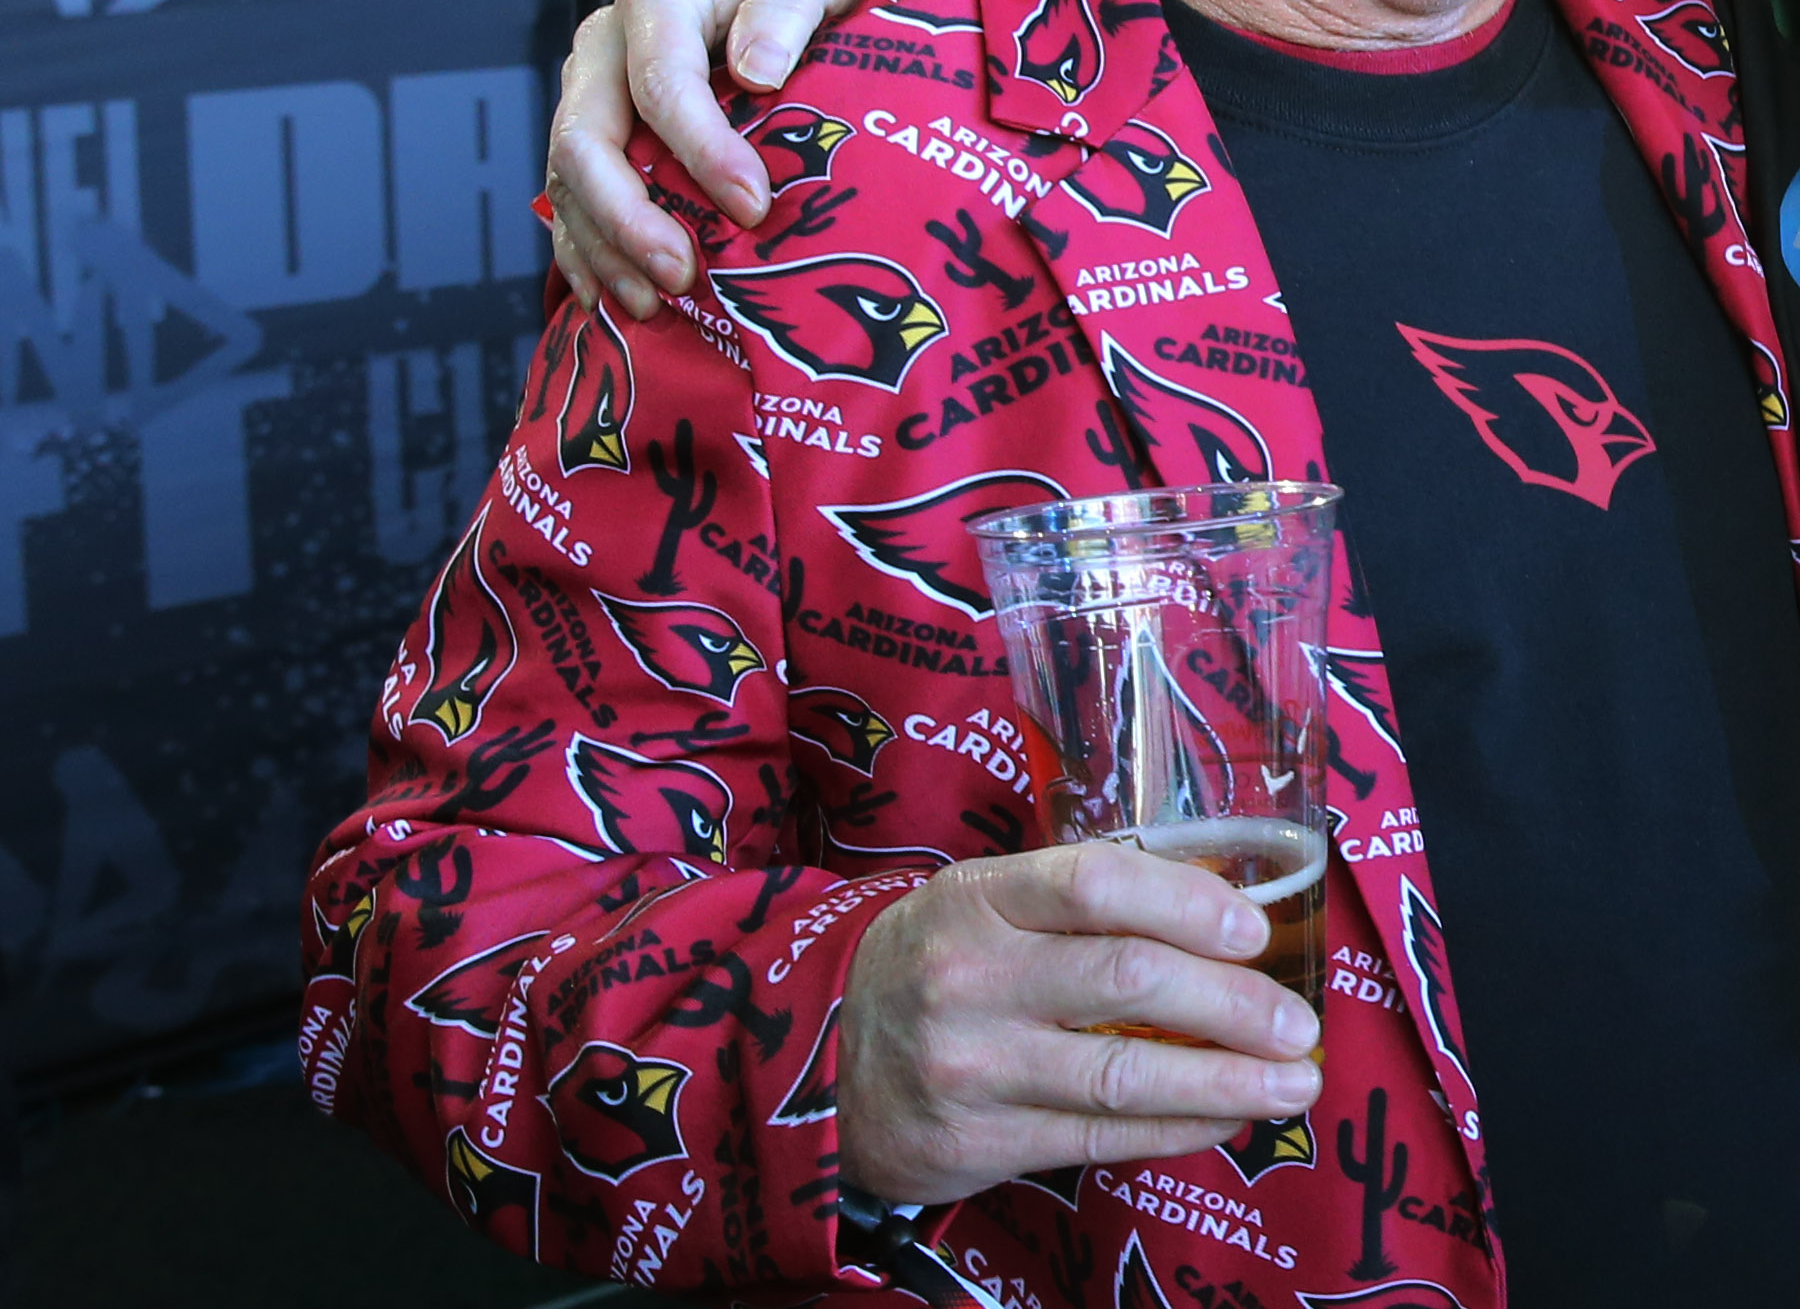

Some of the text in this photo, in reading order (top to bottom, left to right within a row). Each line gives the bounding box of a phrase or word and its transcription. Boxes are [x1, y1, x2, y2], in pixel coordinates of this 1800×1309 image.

[804, 46, 976, 91] RDINALS
[818, 31, 936, 58] RIZONA
[862, 109, 1028, 221] CARDIN
[927, 115, 1053, 199] ARIZON
[1066, 266, 1250, 316] ARDINALS
[1077, 252, 1200, 288] ARIZONA
[677, 295, 741, 340] ARIZO
[951, 311, 1077, 384] ARIZO
[755, 392, 843, 426] IZONA
[757, 414, 882, 459] INALS
[498, 453, 594, 568] ARDINALS
[514, 443, 573, 521] ARIZONA
[488, 538, 619, 730] CARDINALS
[523, 565, 603, 683] ARIZONA
[797, 609, 1011, 678] CARDINALS
[844, 602, 979, 652] ARIZONA
[902, 713, 1038, 803] CARDI
[766, 875, 928, 985] CARDINA
[480, 933, 577, 1149] CARDINALS
[633, 1169, 706, 1288] INALS
[1094, 1168, 1300, 1272] CARDINALS
[1135, 1168, 1265, 1228] ARIZONA
[611, 1199, 657, 1283] IZONA
